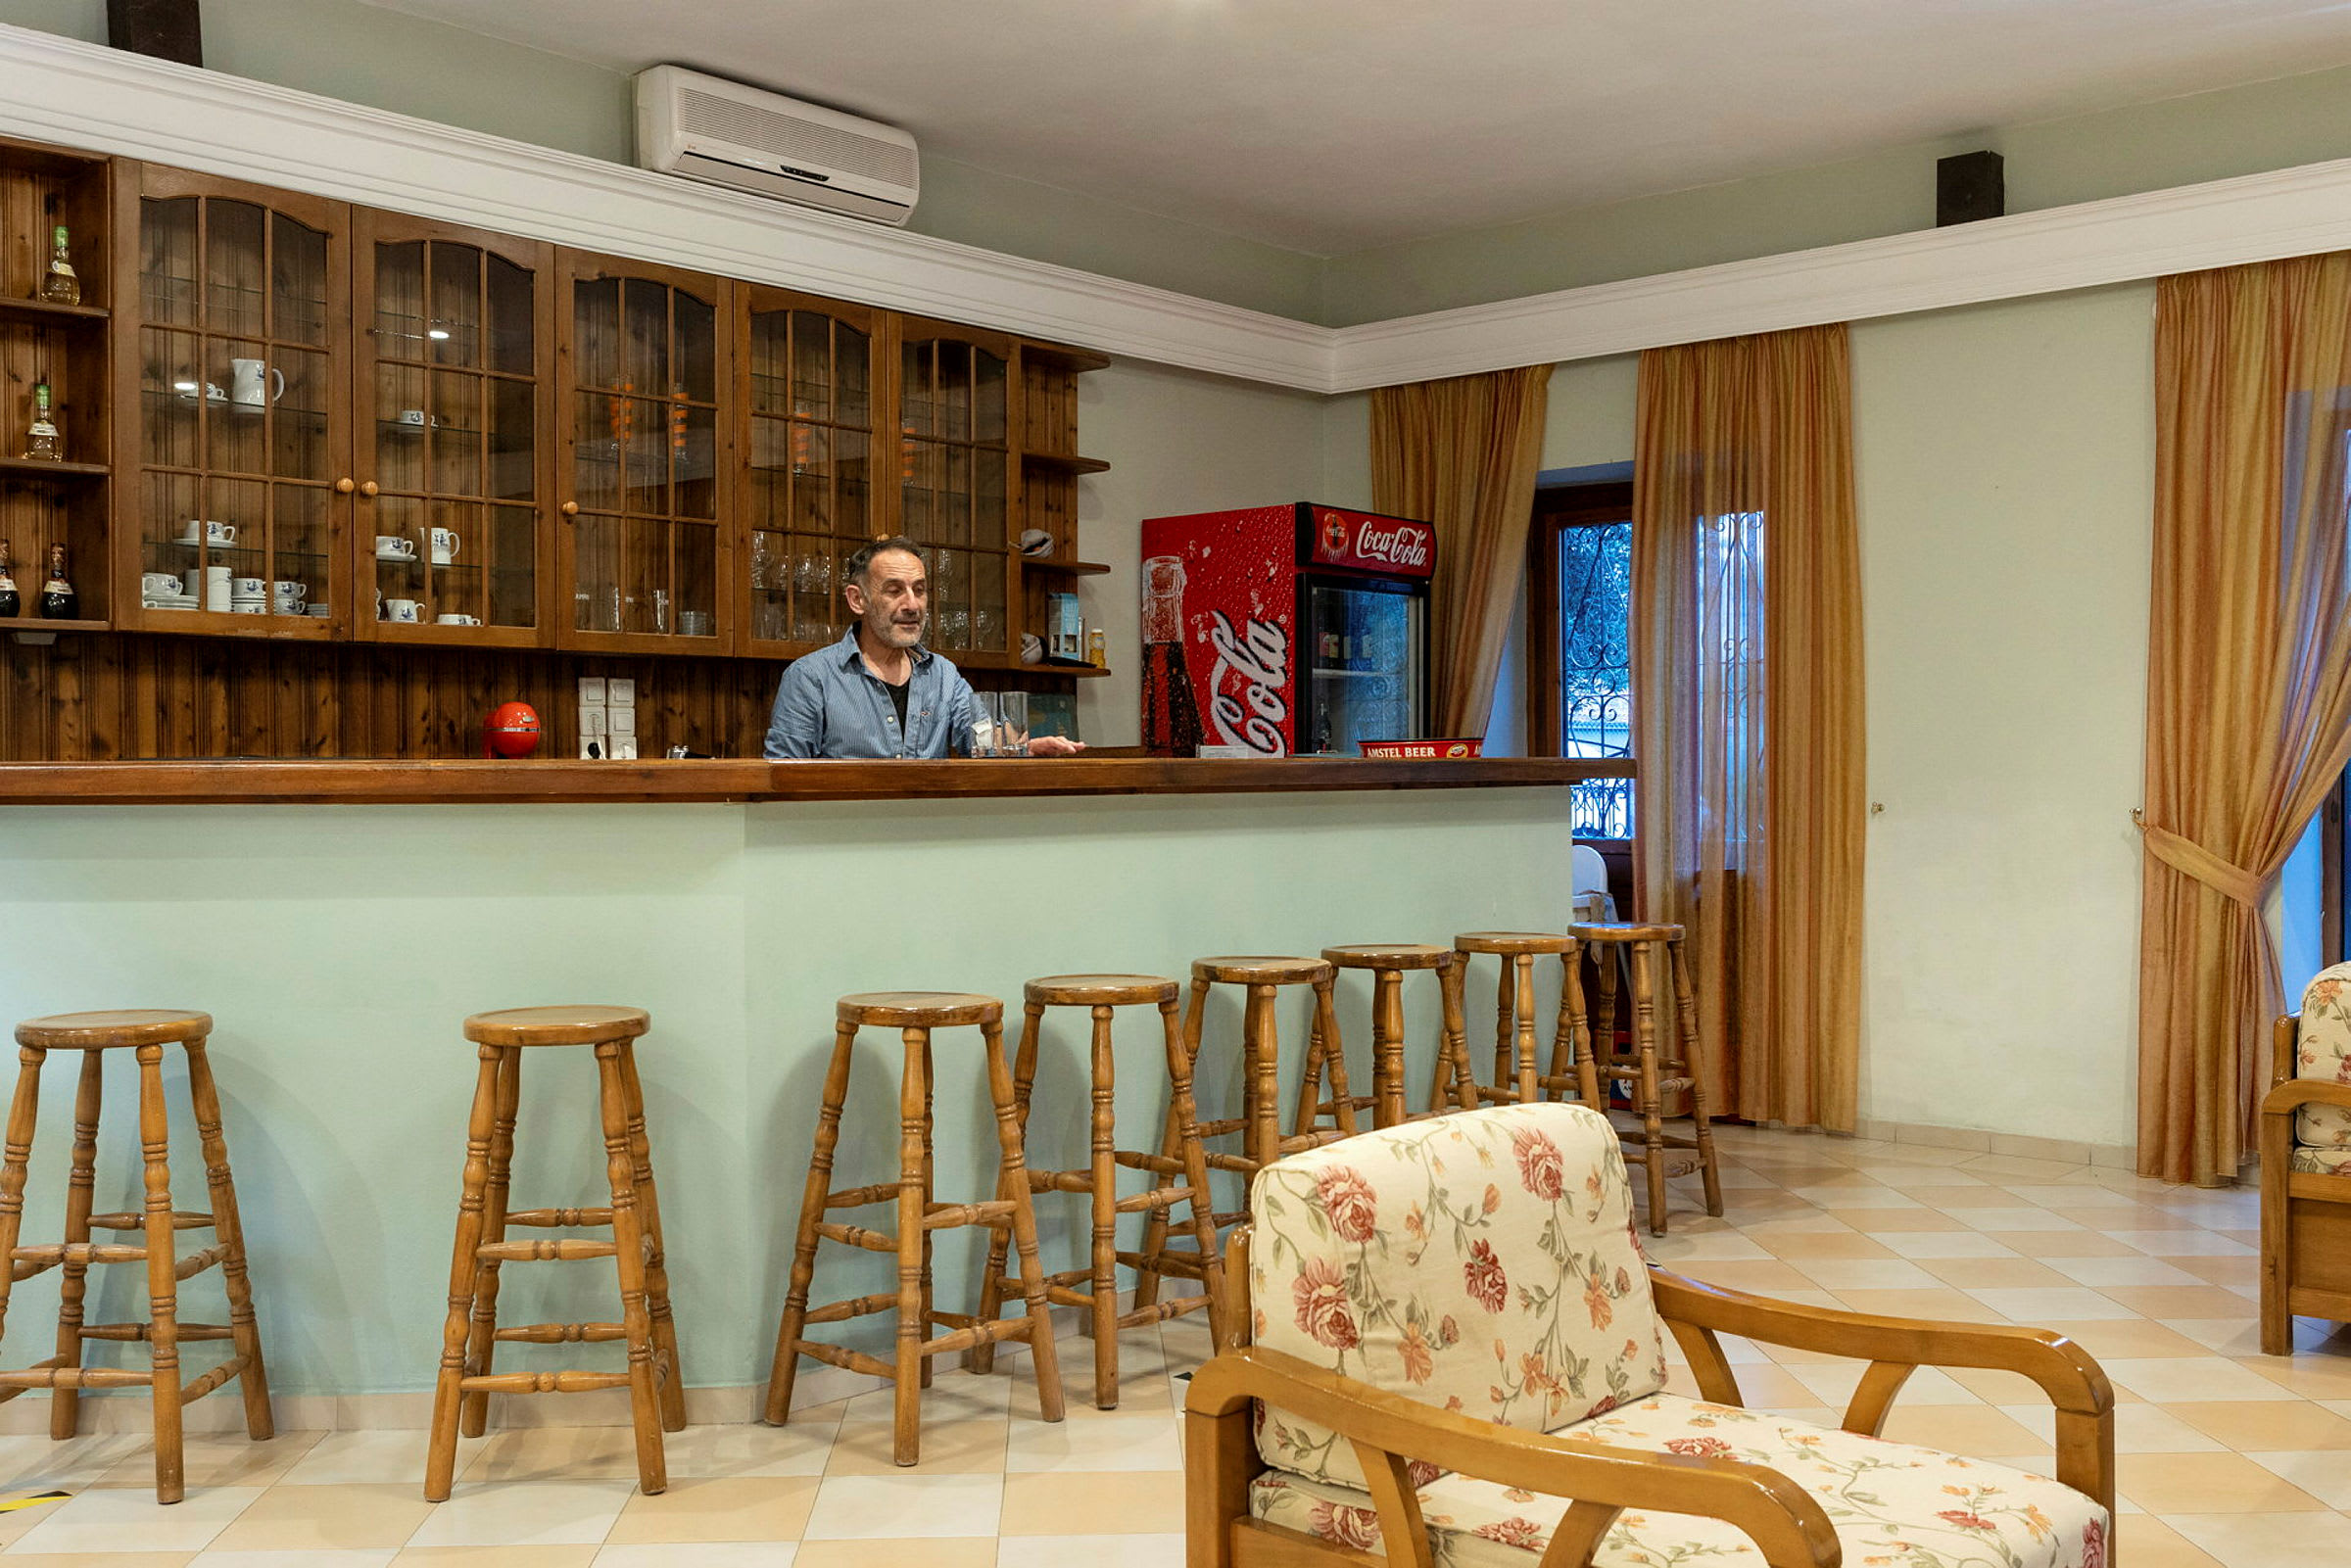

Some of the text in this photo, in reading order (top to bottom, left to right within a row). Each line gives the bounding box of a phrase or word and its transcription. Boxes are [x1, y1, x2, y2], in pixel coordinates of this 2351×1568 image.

[1356, 521, 1426, 566] Coca-Cola
[1367, 746, 1436, 758] AMSTEL BEER
